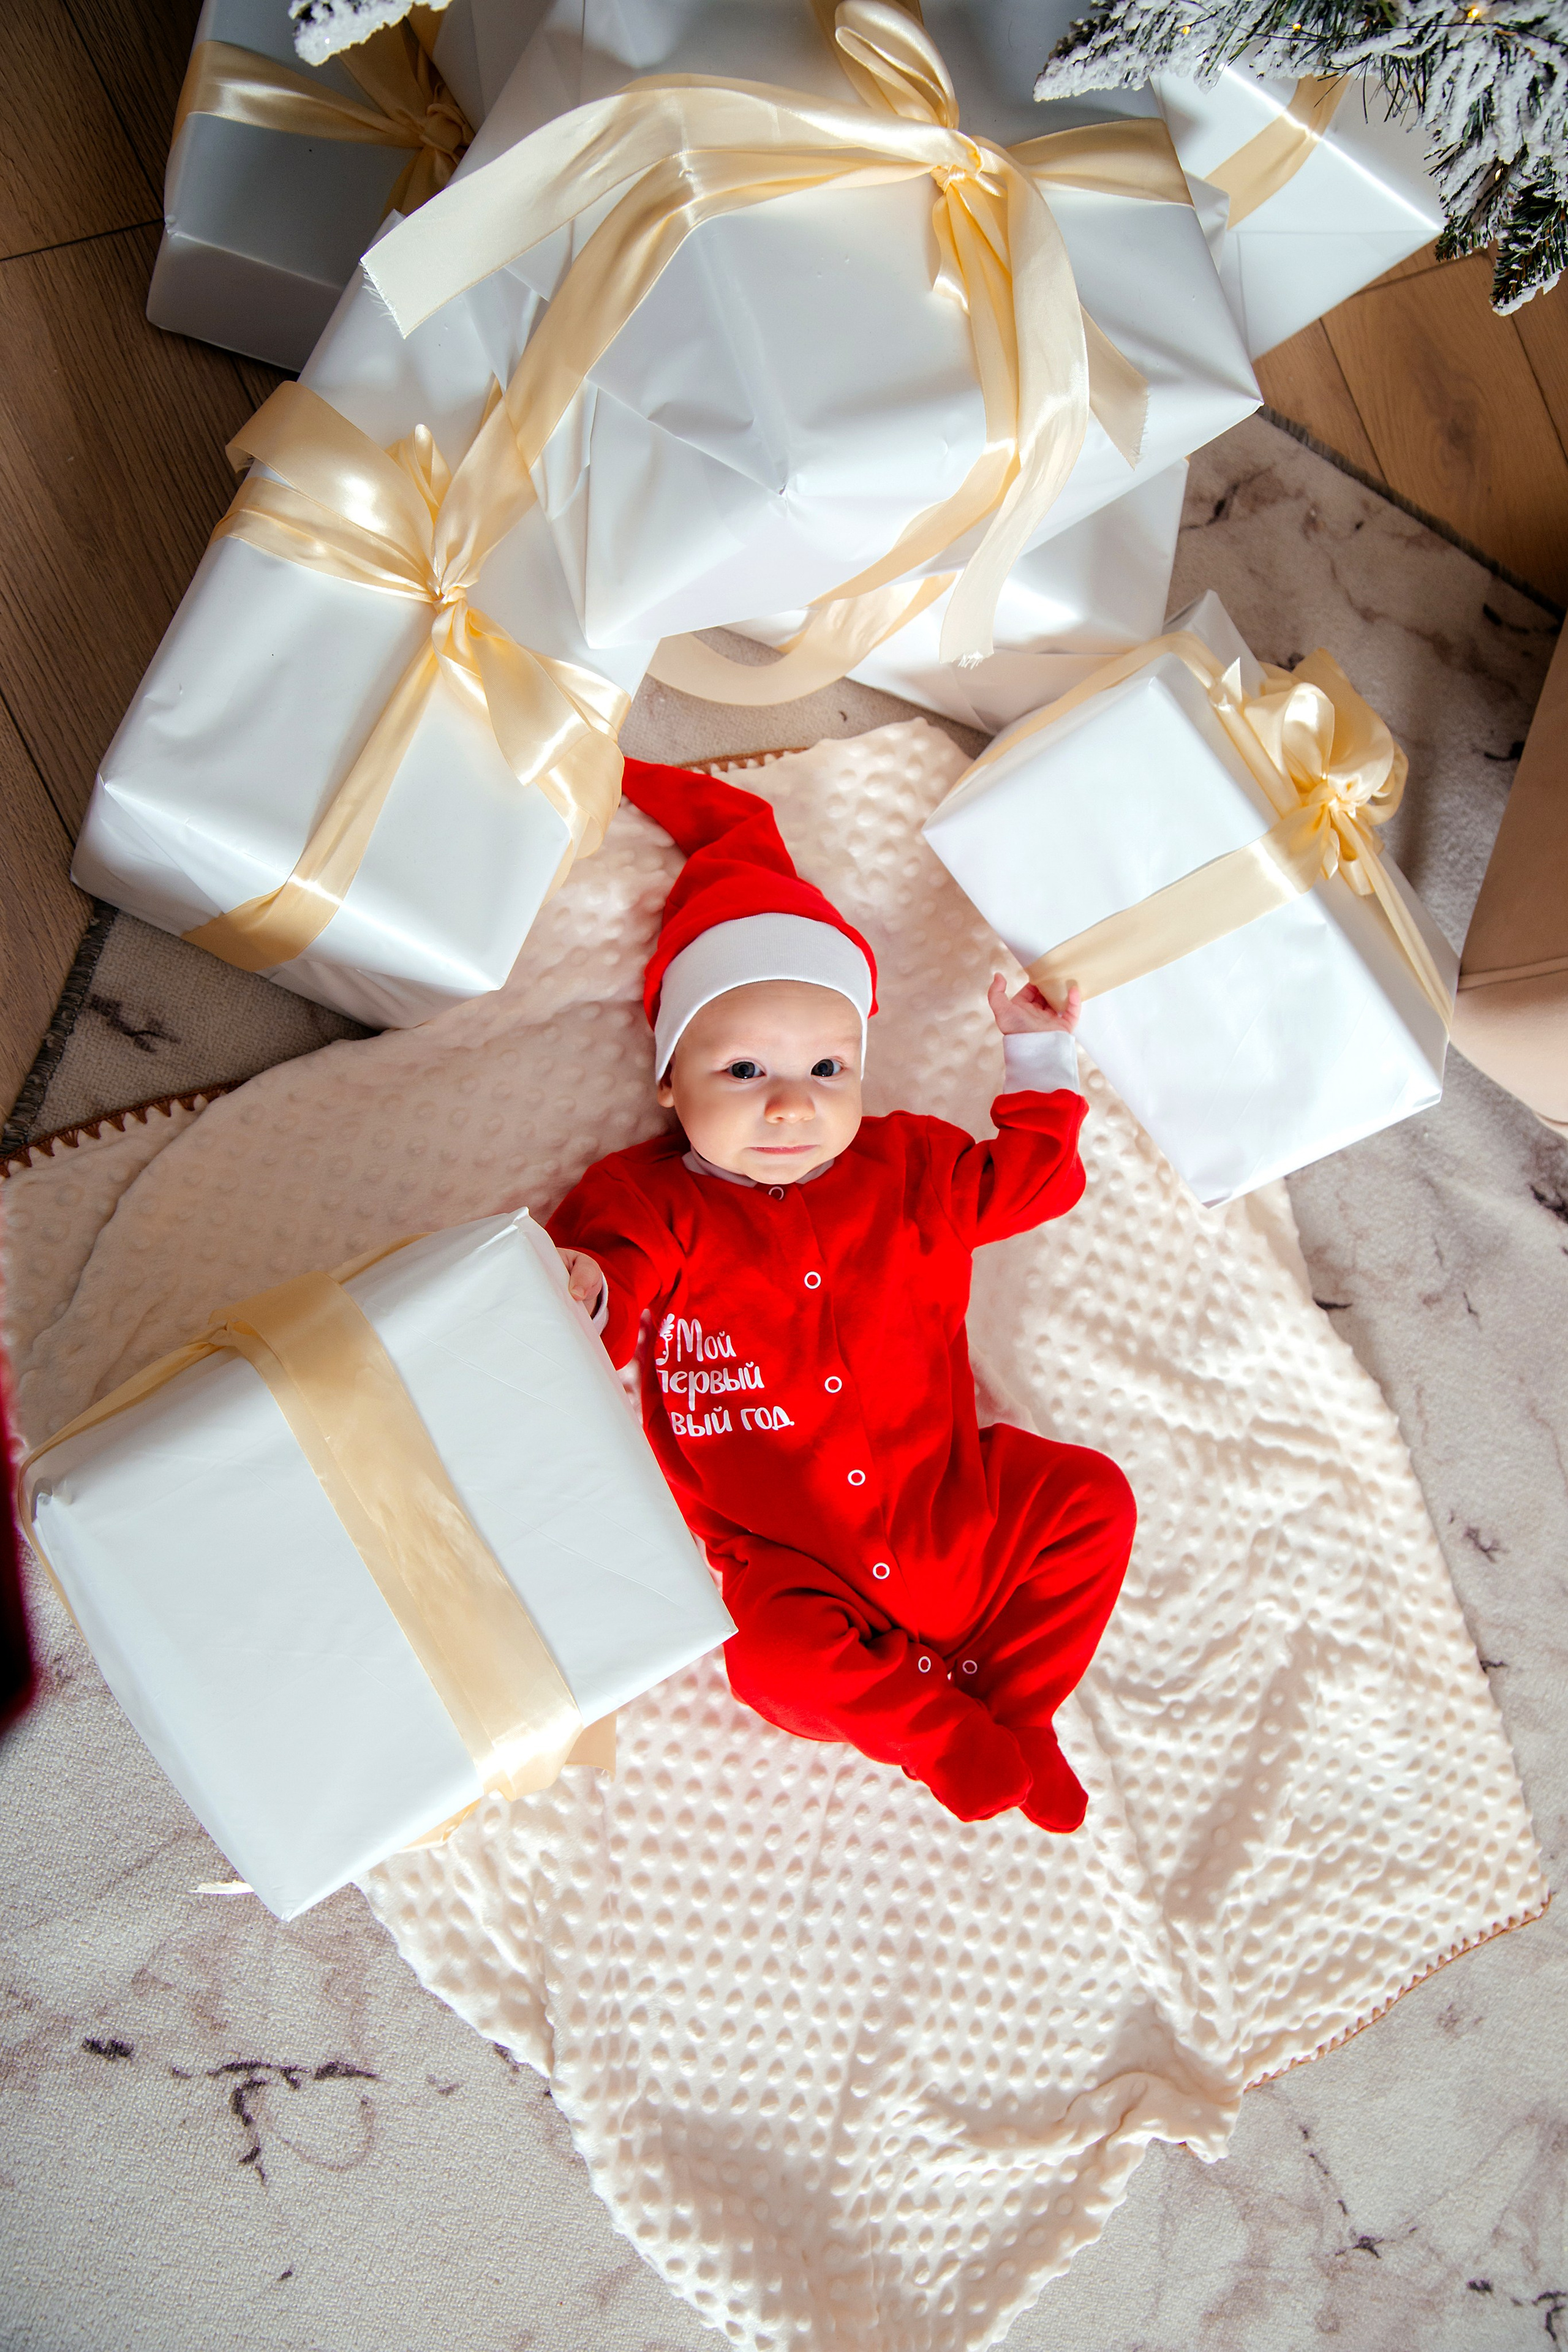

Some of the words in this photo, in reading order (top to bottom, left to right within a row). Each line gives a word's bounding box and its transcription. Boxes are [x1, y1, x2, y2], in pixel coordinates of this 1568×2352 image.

[677, 1318, 737, 1362] Мой
[669, 1406, 733, 1437] вый
[740, 1406, 795, 1431] год
